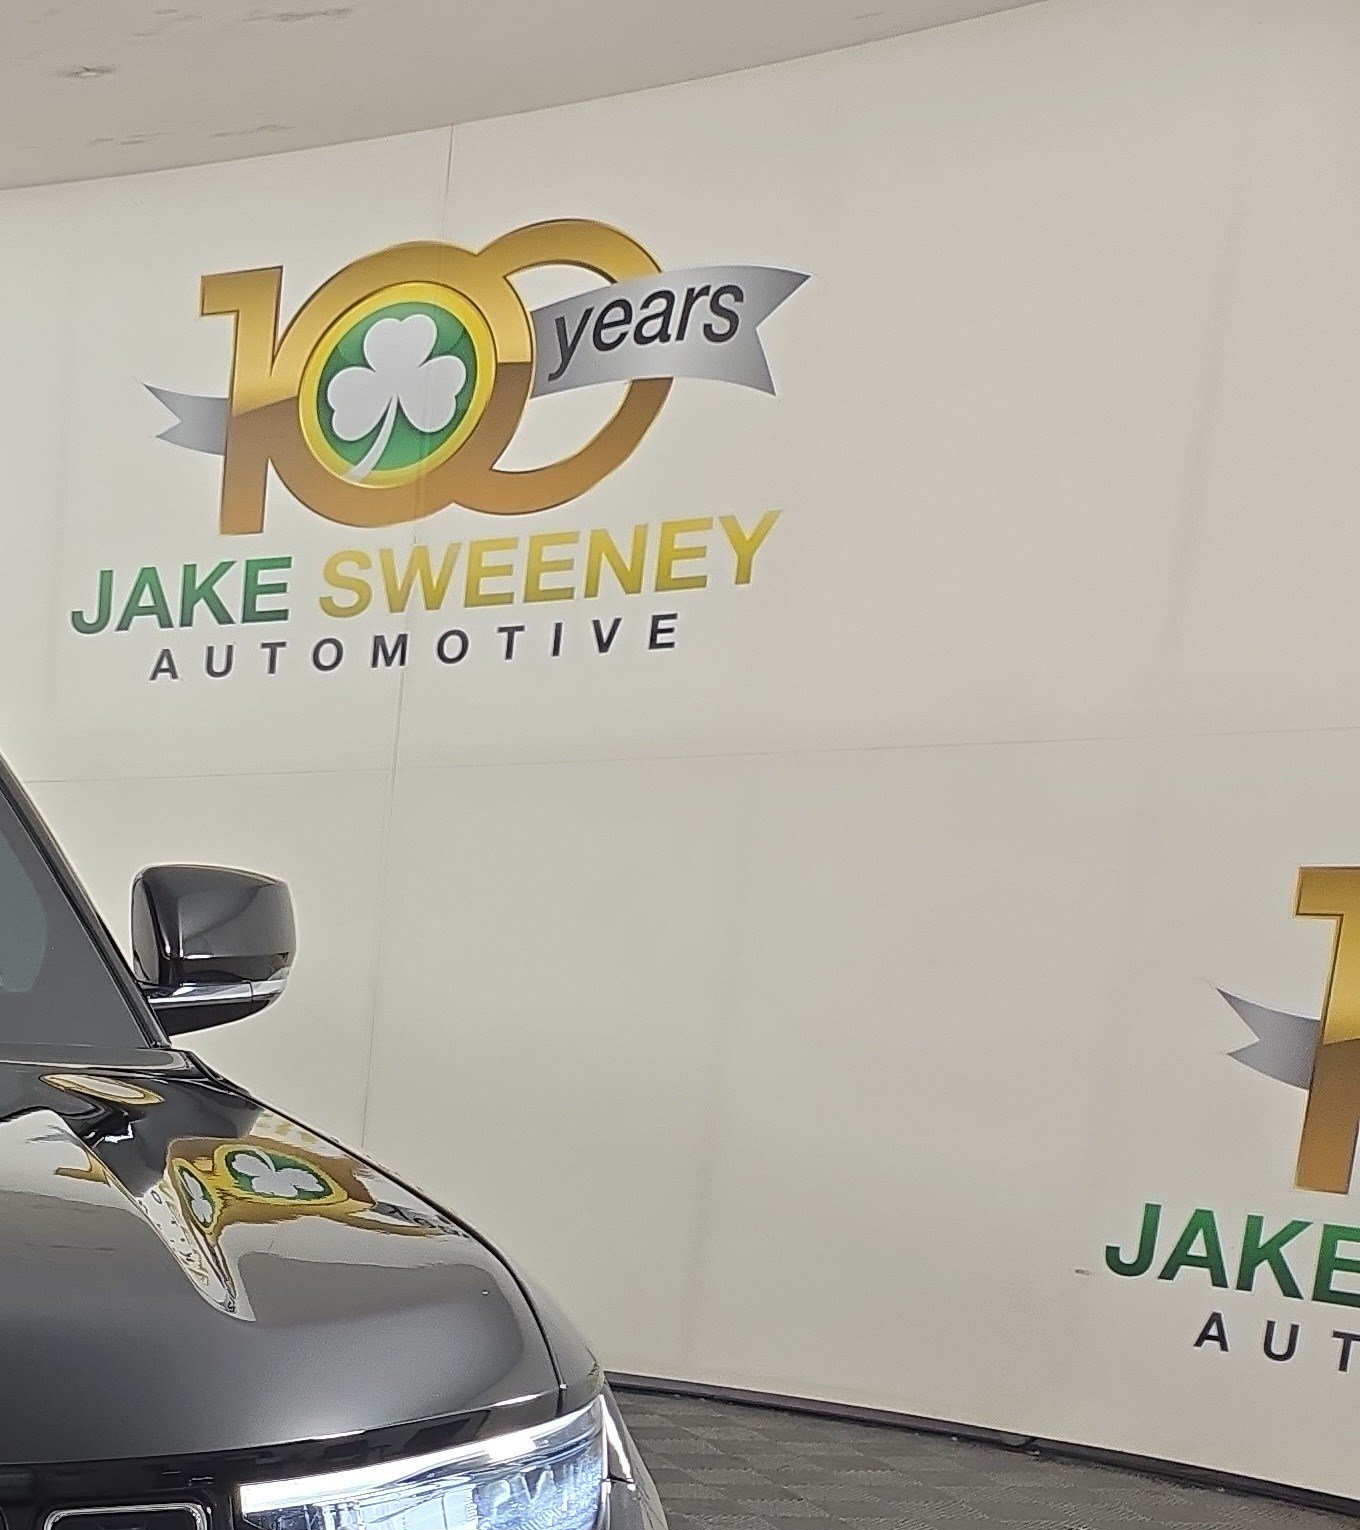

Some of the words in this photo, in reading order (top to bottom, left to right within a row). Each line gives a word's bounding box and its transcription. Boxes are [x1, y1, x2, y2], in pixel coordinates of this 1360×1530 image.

[549, 281, 745, 383] years
[70, 555, 293, 634] JAKE
[317, 509, 782, 619] SWEENEY
[149, 612, 680, 682] AUTOMOTIVE
